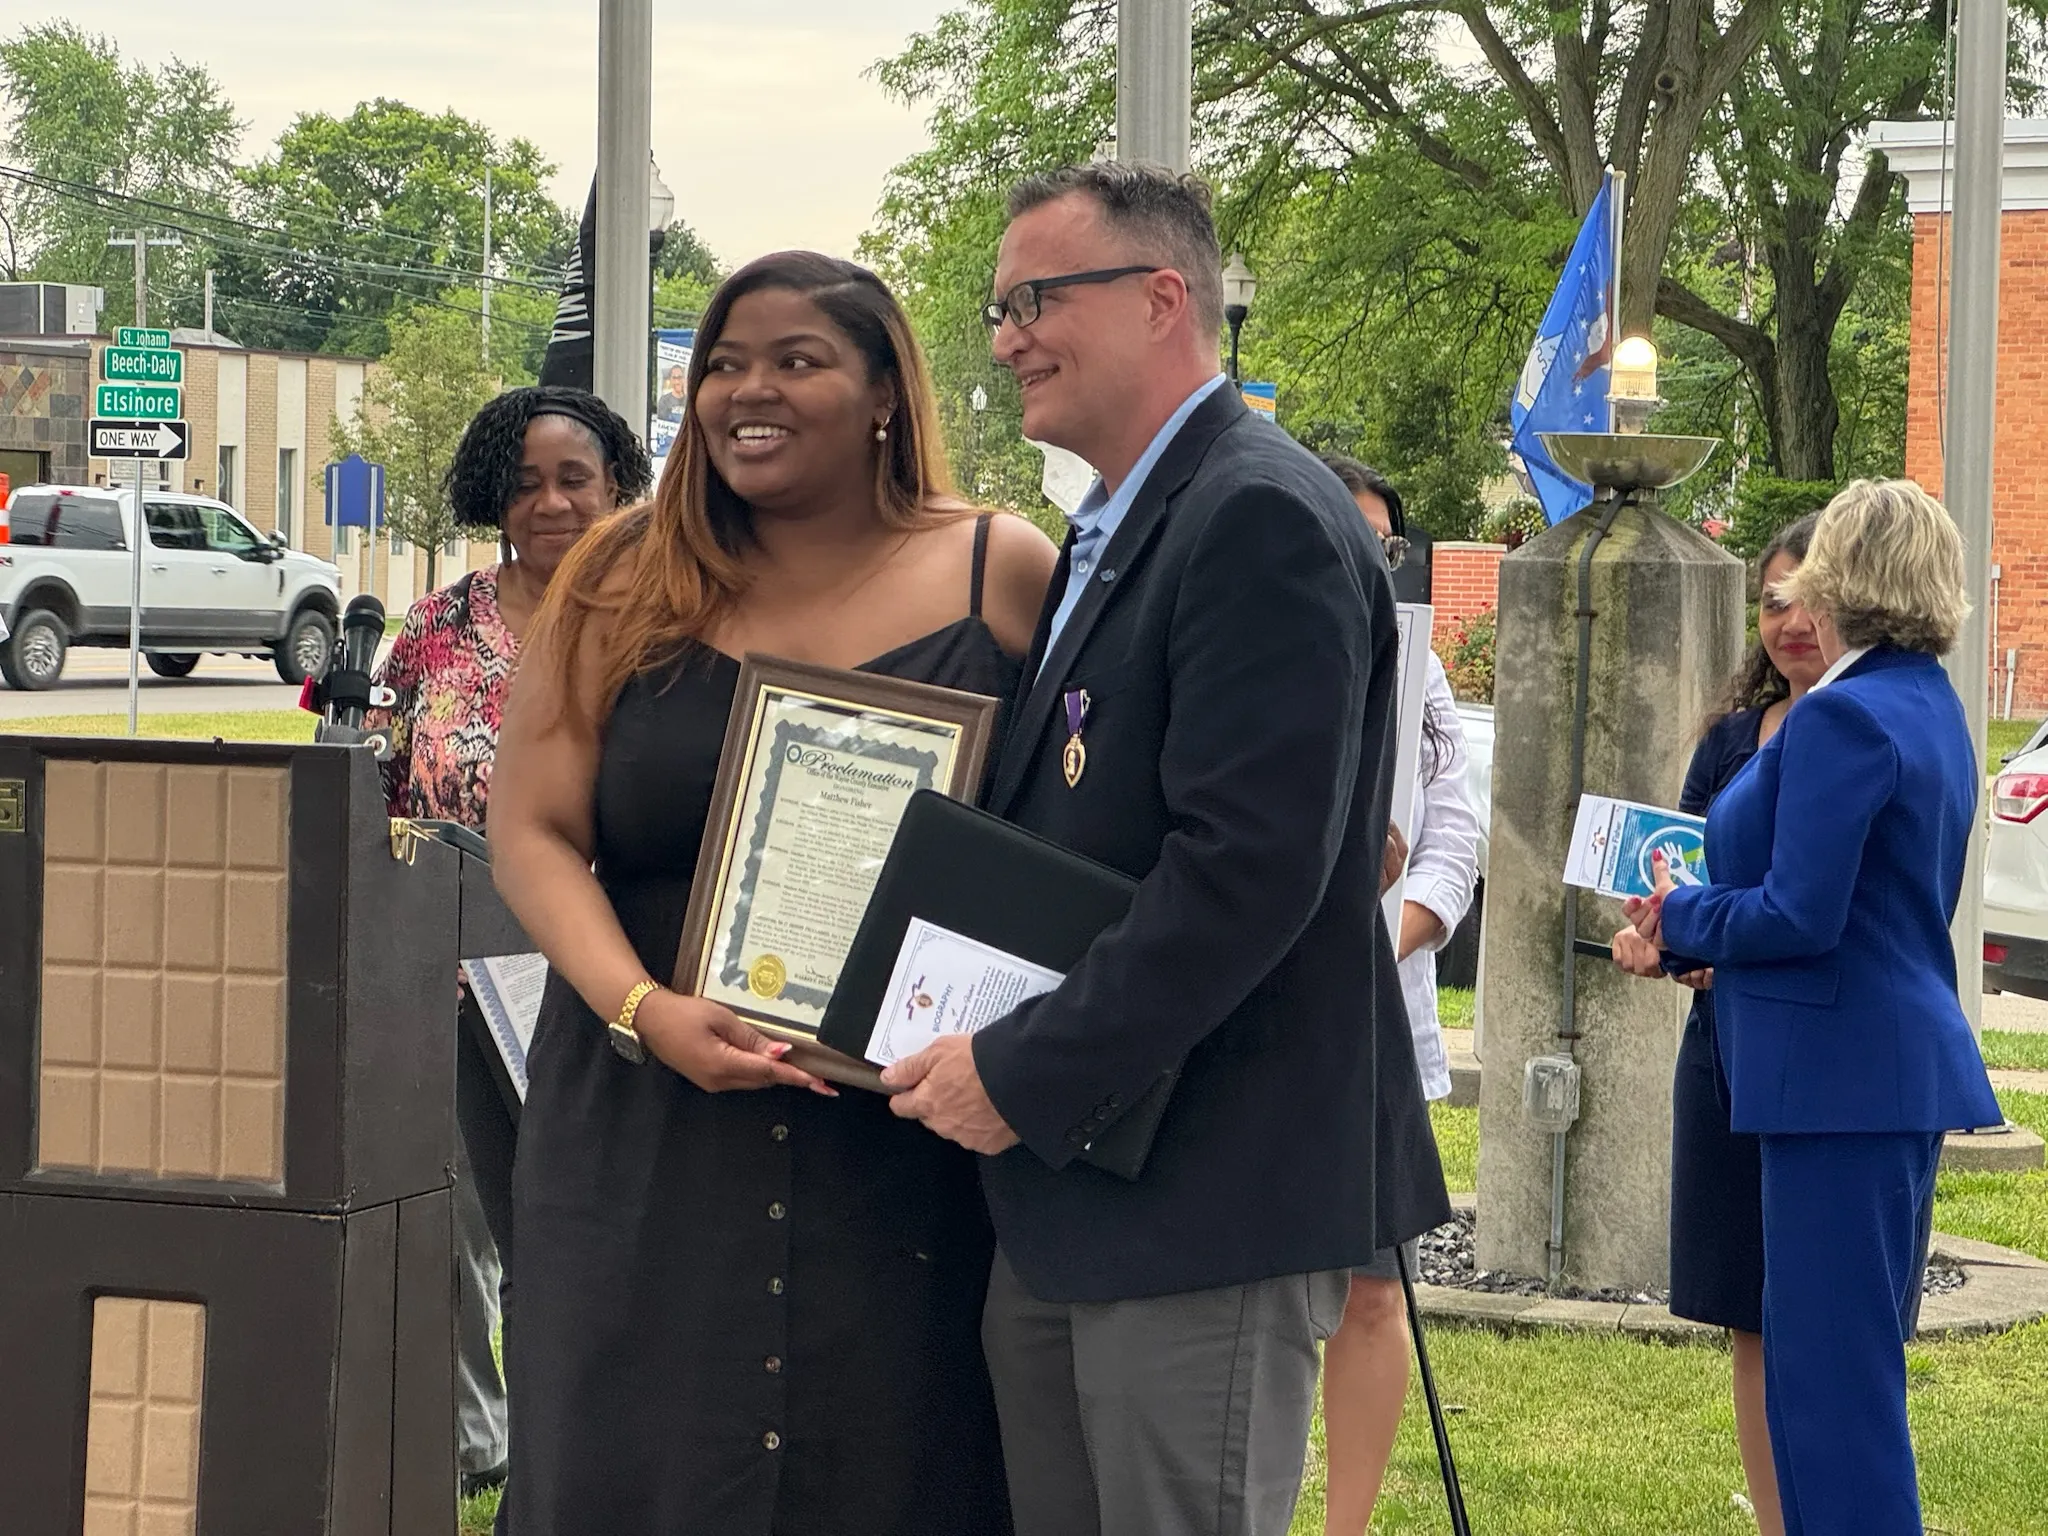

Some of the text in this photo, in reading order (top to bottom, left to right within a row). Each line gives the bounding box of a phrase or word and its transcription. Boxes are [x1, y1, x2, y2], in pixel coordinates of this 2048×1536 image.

[549, 292, 591, 344] MIA
[122, 330, 167, 347] St. Johann
[111, 352, 177, 380] Beech-Daly
[103, 390, 174, 413] Elsinore
[99, 431, 157, 447] ONE WAY
[800, 750, 913, 789] Proclamation
[806, 767, 820, 776] Office
[826, 771, 834, 779] the
[834, 774, 850, 783] Wayne
[849, 777, 866, 787] County
[820, 791, 872, 809] Matthew Fisher
[932, 984, 954, 1033] BIOGRAPHY
